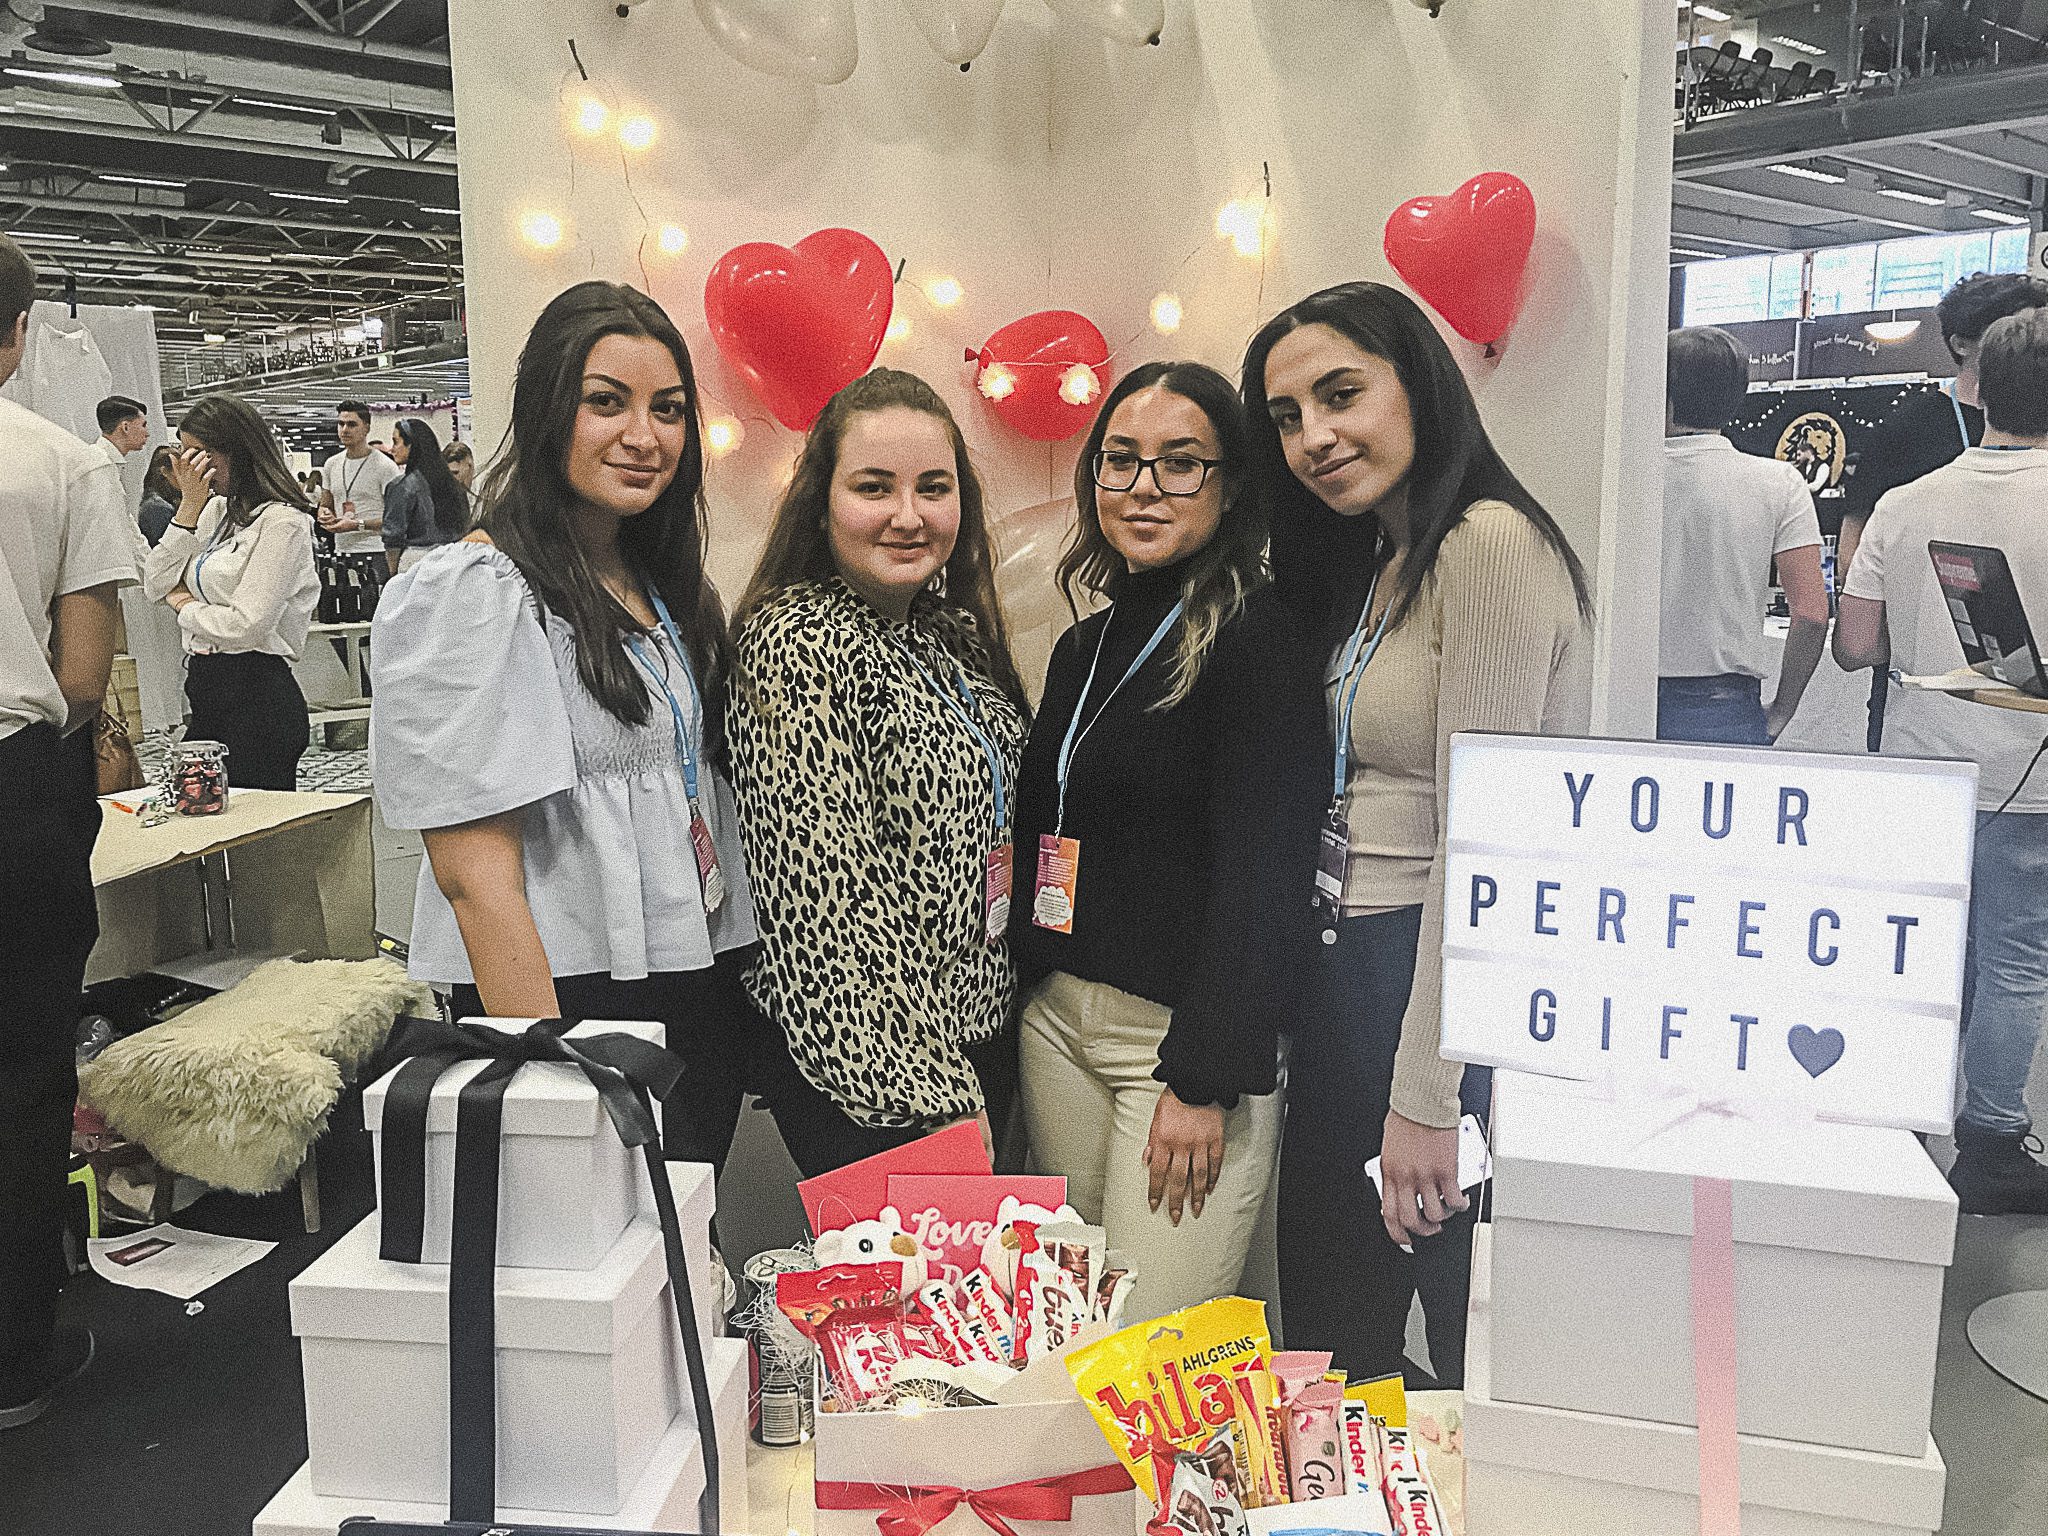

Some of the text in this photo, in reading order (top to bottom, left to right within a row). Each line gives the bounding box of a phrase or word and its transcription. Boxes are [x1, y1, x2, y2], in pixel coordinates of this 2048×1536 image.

[1563, 772, 1809, 847] YOUR
[1469, 874, 1919, 976] PERFECT
[1528, 988, 1759, 1071] GIFT
[911, 1206, 993, 1261] Love
[966, 1274, 1003, 1333] Kinder
[1182, 1336, 1256, 1373] AHLGRENS
[1344, 1406, 1367, 1478] Kinder
